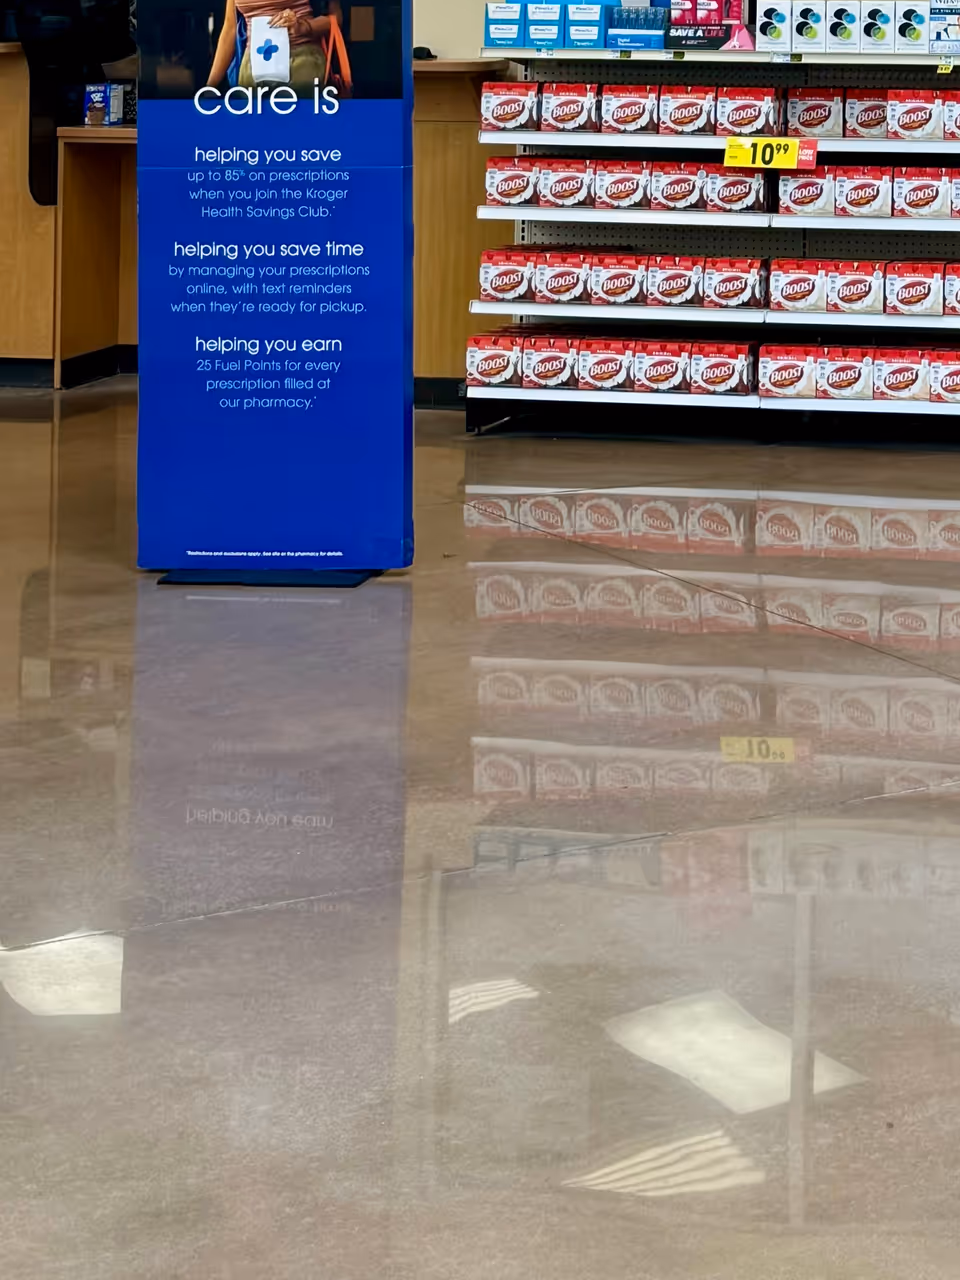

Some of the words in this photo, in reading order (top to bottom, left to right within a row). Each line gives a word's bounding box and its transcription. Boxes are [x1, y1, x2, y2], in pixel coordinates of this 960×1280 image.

[669, 29, 694, 37] SAVE
[696, 29, 703, 37] A
[704, 29, 725, 37] LIFE
[193, 85, 298, 115] care
[313, 77, 339, 115] is
[494, 101, 524, 117] BOOST
[612, 103, 646, 120] BOOST
[669, 104, 703, 122] BOOST
[727, 105, 761, 122] BOOST
[898, 109, 932, 125] BOOST
[195, 146, 259, 166] helping
[263, 149, 296, 165] you
[300, 149, 342, 162] save
[187, 171, 205, 183] up
[207, 170, 222, 182] to
[248, 171, 266, 182] on
[269, 169, 350, 183] prescriptions
[497, 177, 530, 193] BOOST
[606, 179, 639, 196] BOOST
[717, 182, 751, 198] BOOST
[790, 184, 823, 201] BOOST
[189, 187, 225, 200] when
[228, 190, 252, 202] you
[254, 188, 278, 202] join
[280, 187, 303, 200] the
[306, 187, 349, 202] Kroger
[201, 206, 243, 218] Health
[246, 205, 295, 220] Savings
[174, 241, 239, 261] helping
[243, 244, 275, 260] you
[280, 243, 321, 257] save
[325, 240, 364, 257] time
[168, 264, 185, 278] by
[188, 264, 255, 279] managing
[258, 266, 287, 278] your
[289, 264, 371, 278] prescriptions
[186, 282, 228, 295] online,
[231, 282, 258, 294] with
[262, 282, 286, 294] text
[289, 282, 352, 294] reminders
[546, 274, 577, 290] BOOST
[658, 277, 691, 293] BOOST
[781, 279, 816, 296] BOOST
[896, 282, 931, 300] BOOST
[170, 301, 206, 313] when
[209, 301, 255, 314] they're
[258, 301, 296, 315] ready
[299, 300, 317, 313] for
[319, 300, 367, 315] pickup.
[195, 336, 260, 356] helping
[264, 339, 297, 355] you
[301, 339, 342, 352] earn
[196, 359, 212, 371] 25
[215, 359, 241, 372] Fuel
[244, 359, 282, 371] Points
[284, 359, 302, 371] for
[304, 361, 341, 373] every
[477, 355, 510, 371] BOOST
[589, 360, 622, 376] BOOST
[701, 364, 735, 381] BOOST
[769, 365, 803, 383] BOOST
[883, 369, 918, 386] BOOST
[206, 377, 281, 392] prescription
[284, 377, 314, 390] filled
[316, 377, 331, 390] at
[219, 398, 241, 408] our
